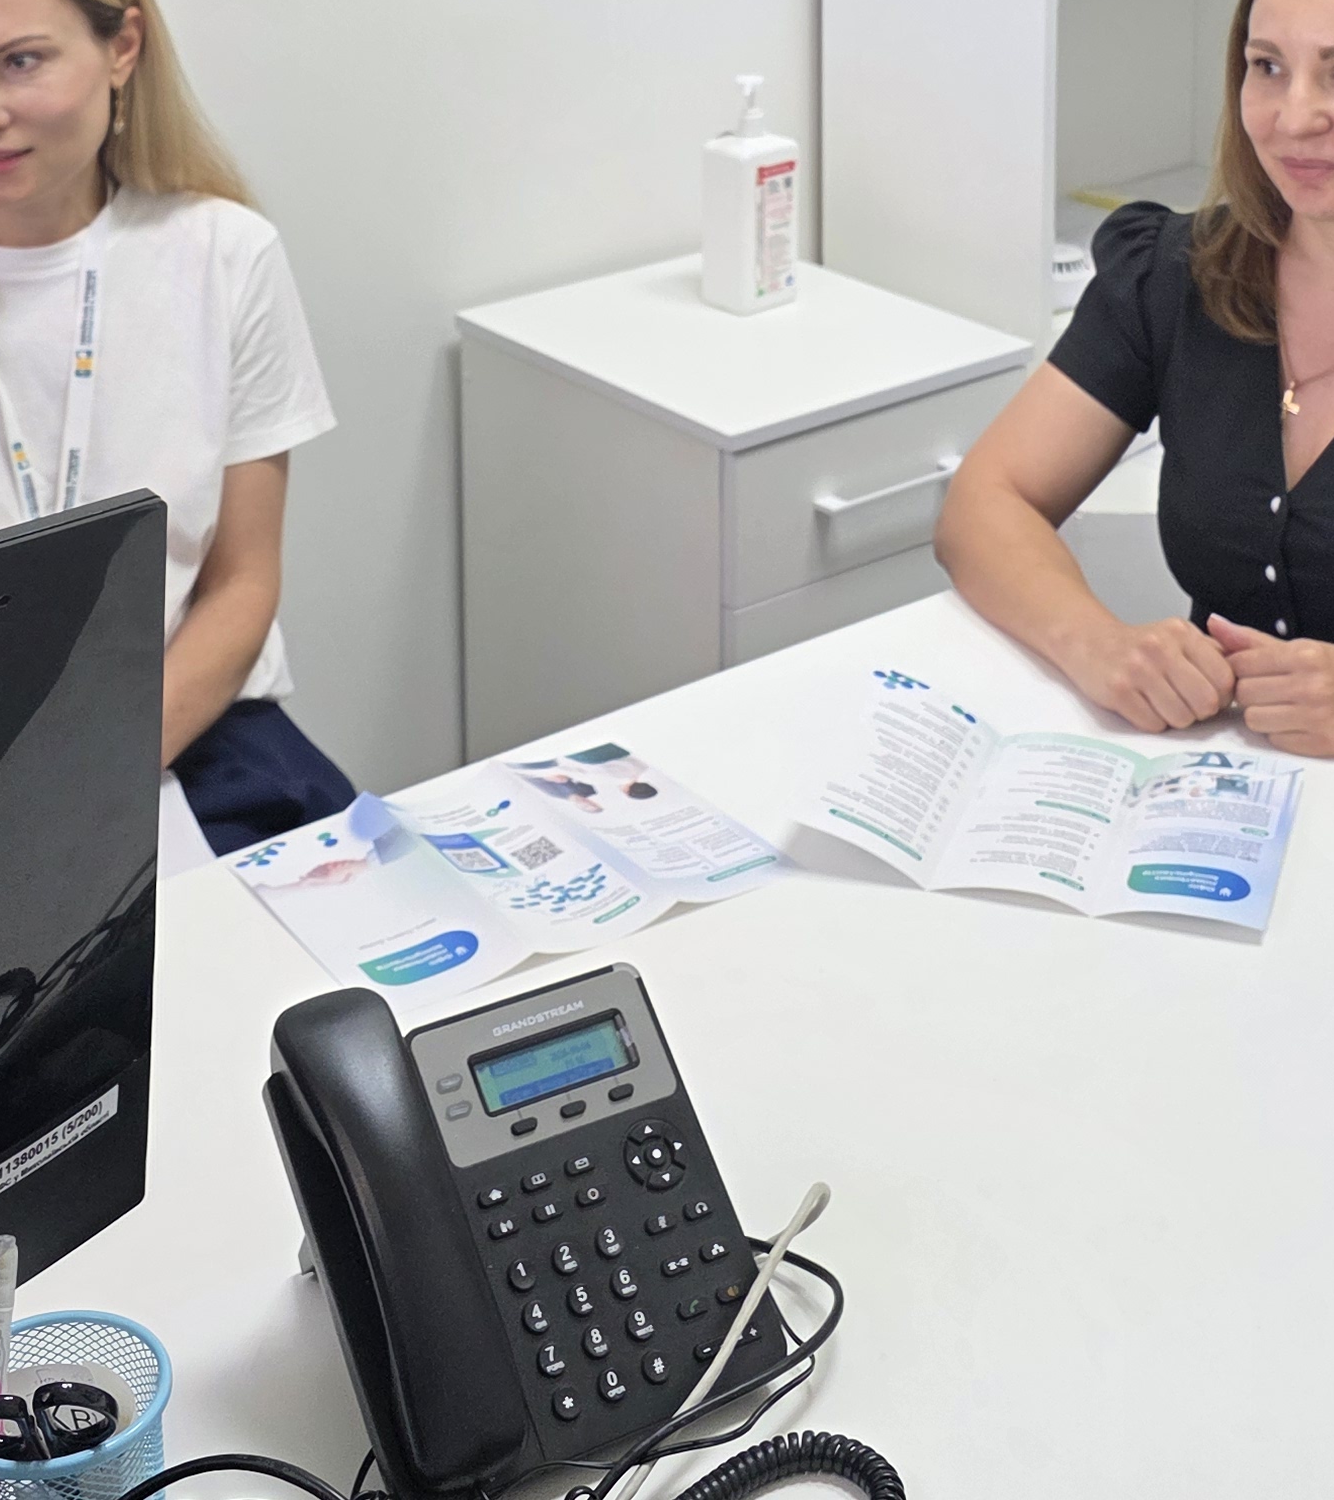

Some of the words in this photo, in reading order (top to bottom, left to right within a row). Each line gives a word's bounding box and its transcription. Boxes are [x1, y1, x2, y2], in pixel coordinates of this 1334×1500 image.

[492, 1000, 585, 1037] GRANDSTREAM
[61, 1101, 103, 1140] (5/200)
[516, 1262, 527, 1277] 1
[559, 1245, 572, 1261] 2
[603, 1228, 616, 1243] 3
[532, 1303, 542, 1319] 4
[575, 1286, 588, 1302] 5
[619, 1269, 631, 1284] 6
[544, 1345, 555, 1362] 7
[590, 1328, 602, 1344] 8
[634, 1311, 646, 1326] 9
[606, 1371, 618, 1387] 0
[652, 1357, 665, 1375] #
